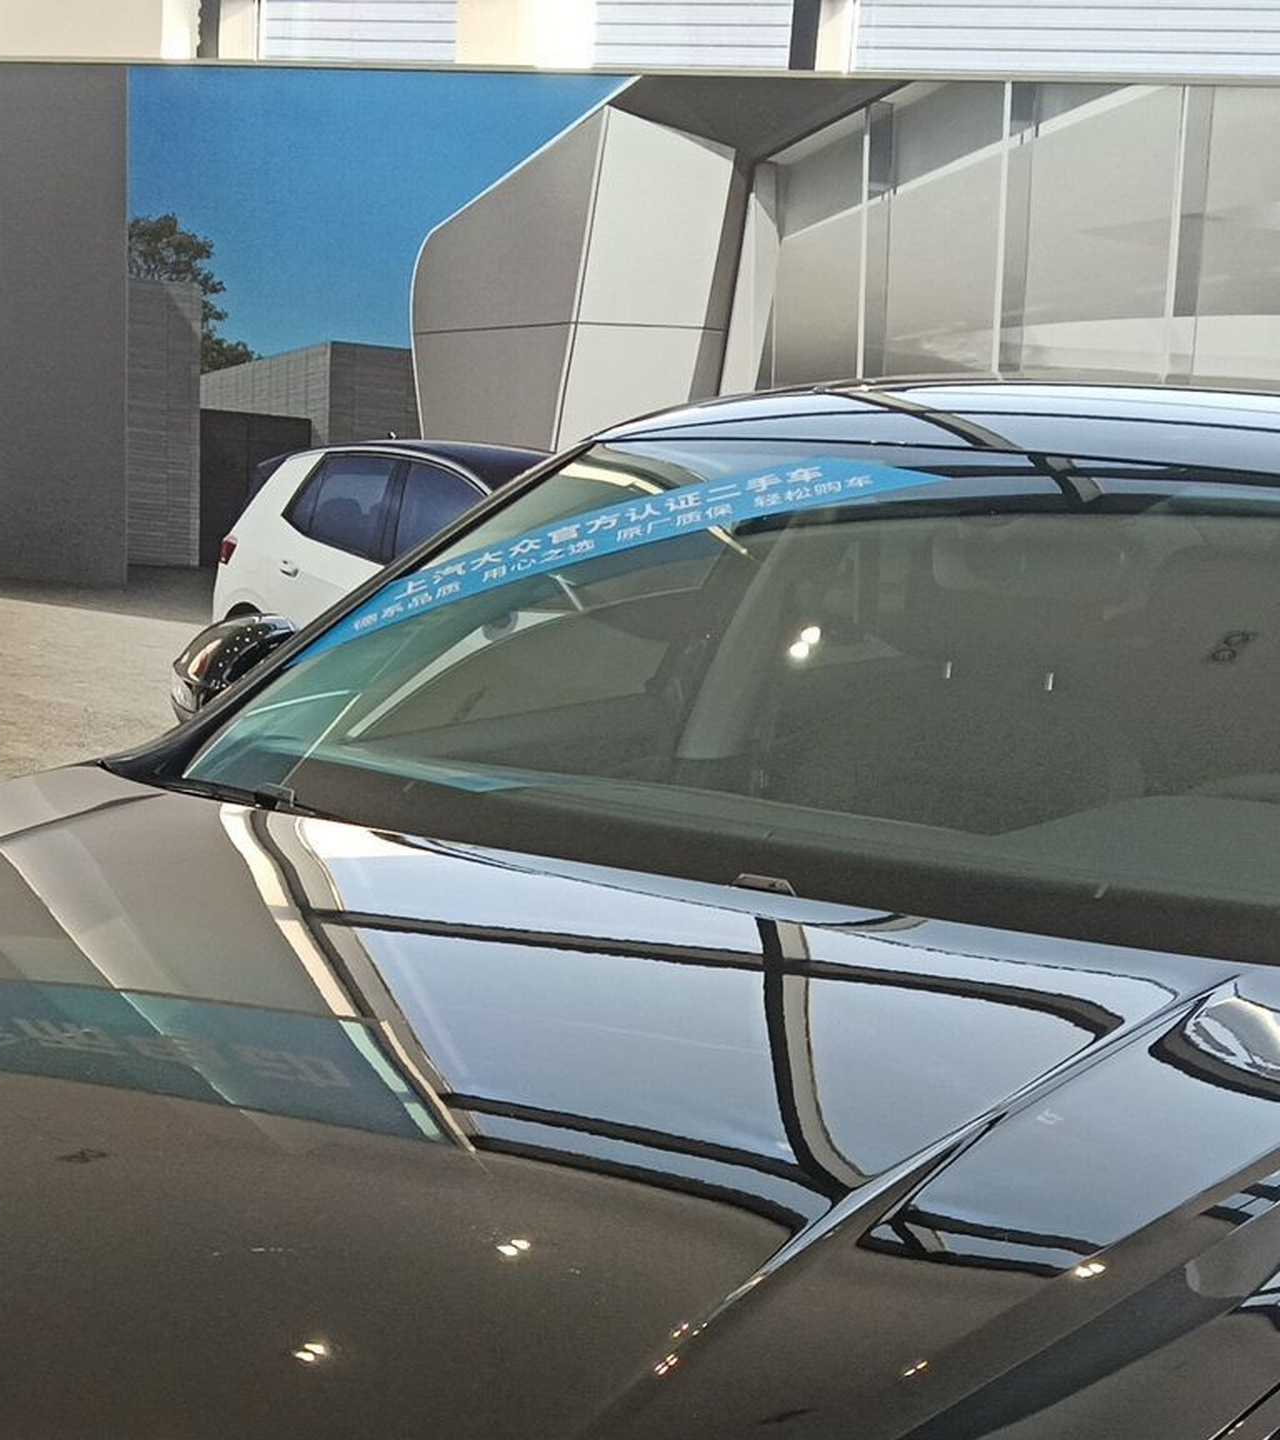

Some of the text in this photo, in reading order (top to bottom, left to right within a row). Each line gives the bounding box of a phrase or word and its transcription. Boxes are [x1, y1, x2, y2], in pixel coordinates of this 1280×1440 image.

[394, 465, 823, 600] 上汽大众官方认证二手车
[482, 538, 596, 583] 用心之选
[616, 502, 733, 542] 原厂质保
[754, 474, 873, 509] 轻松购车
